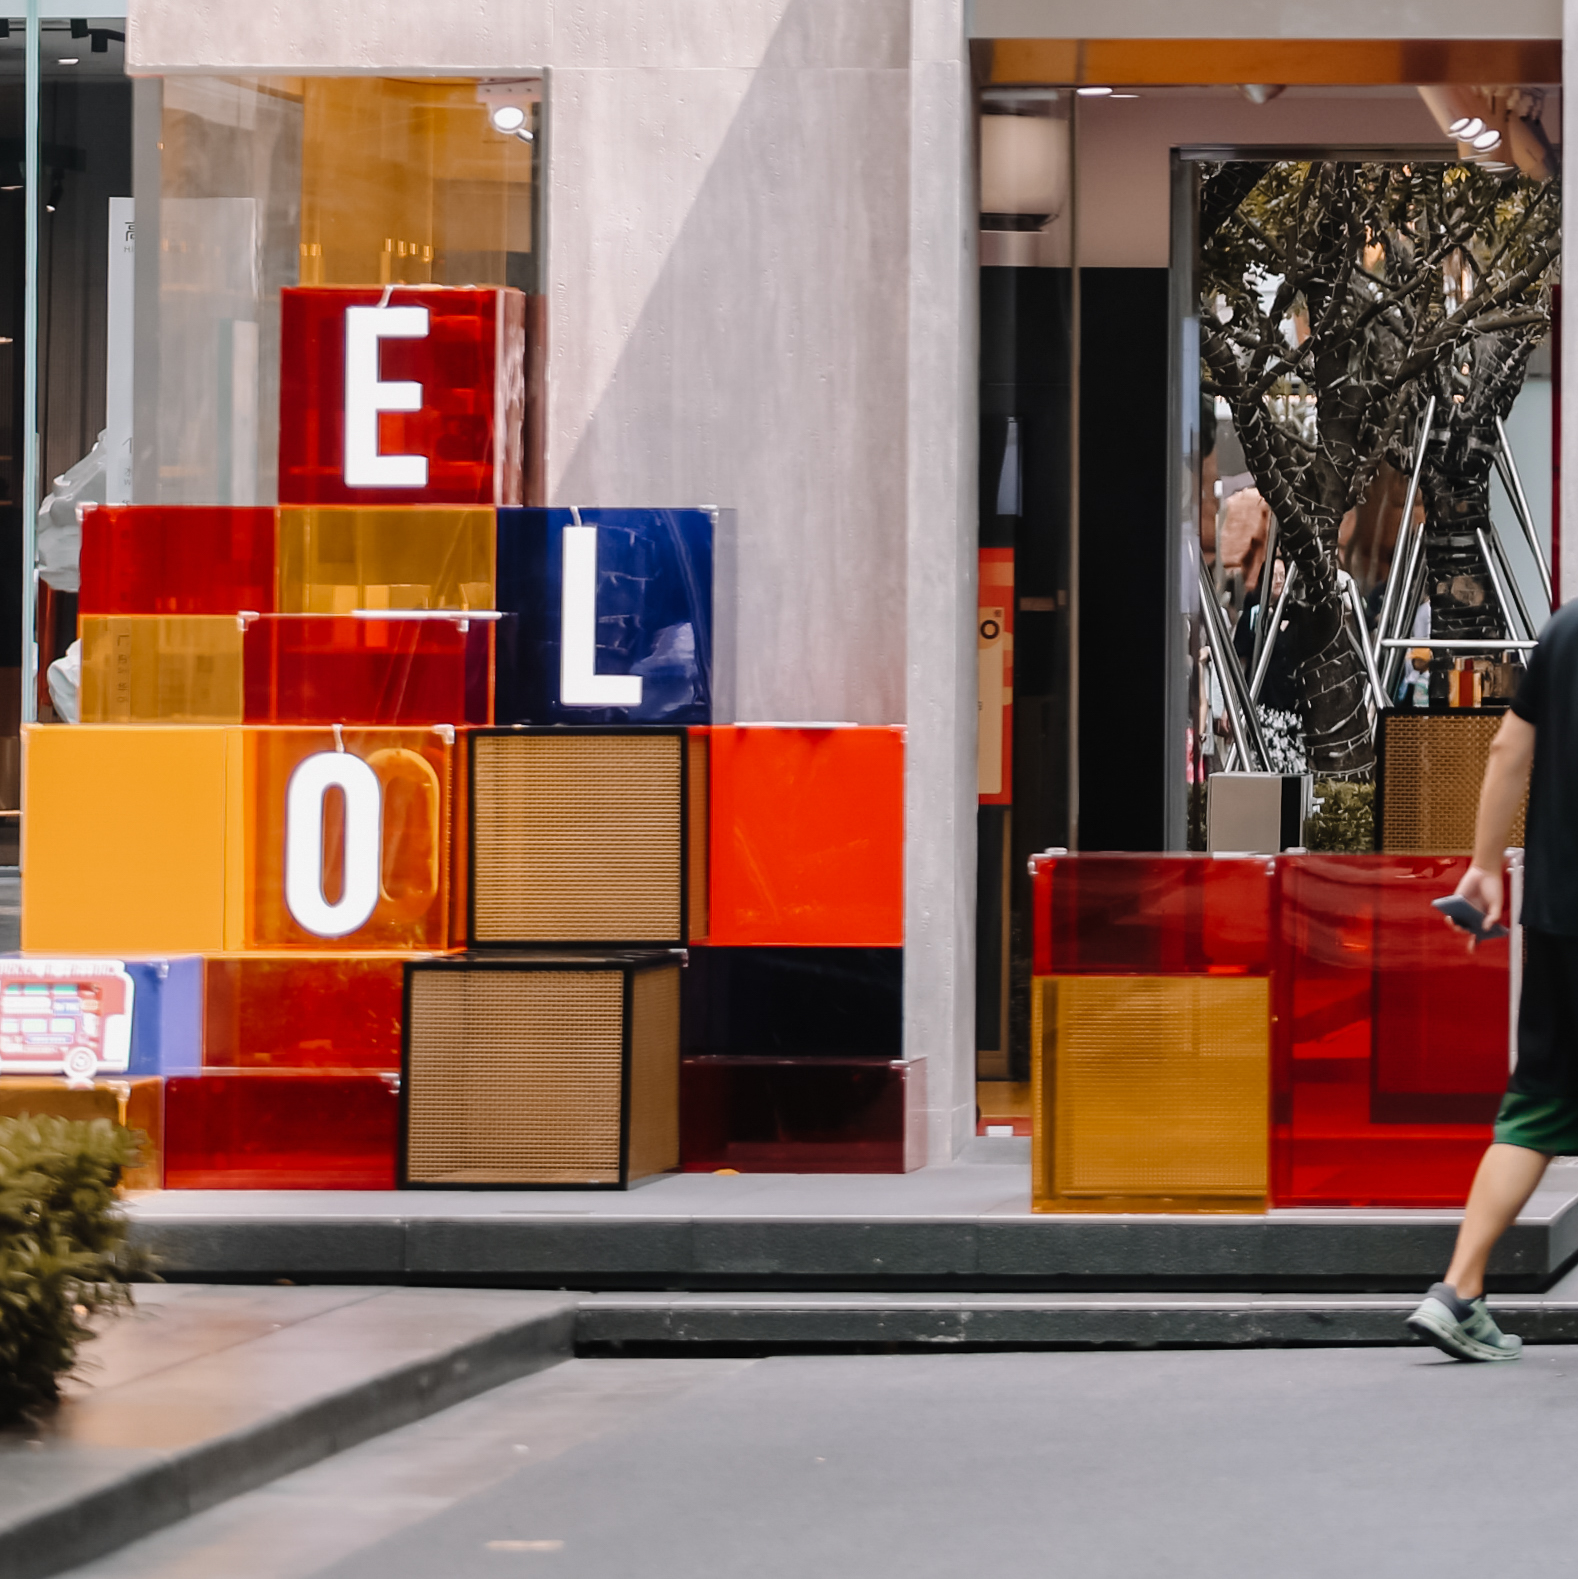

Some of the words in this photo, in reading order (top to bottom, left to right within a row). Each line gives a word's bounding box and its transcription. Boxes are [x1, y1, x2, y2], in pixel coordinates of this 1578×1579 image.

[344, 306, 430, 488] E
[561, 526, 643, 707] L
[285, 750, 382, 938] O
